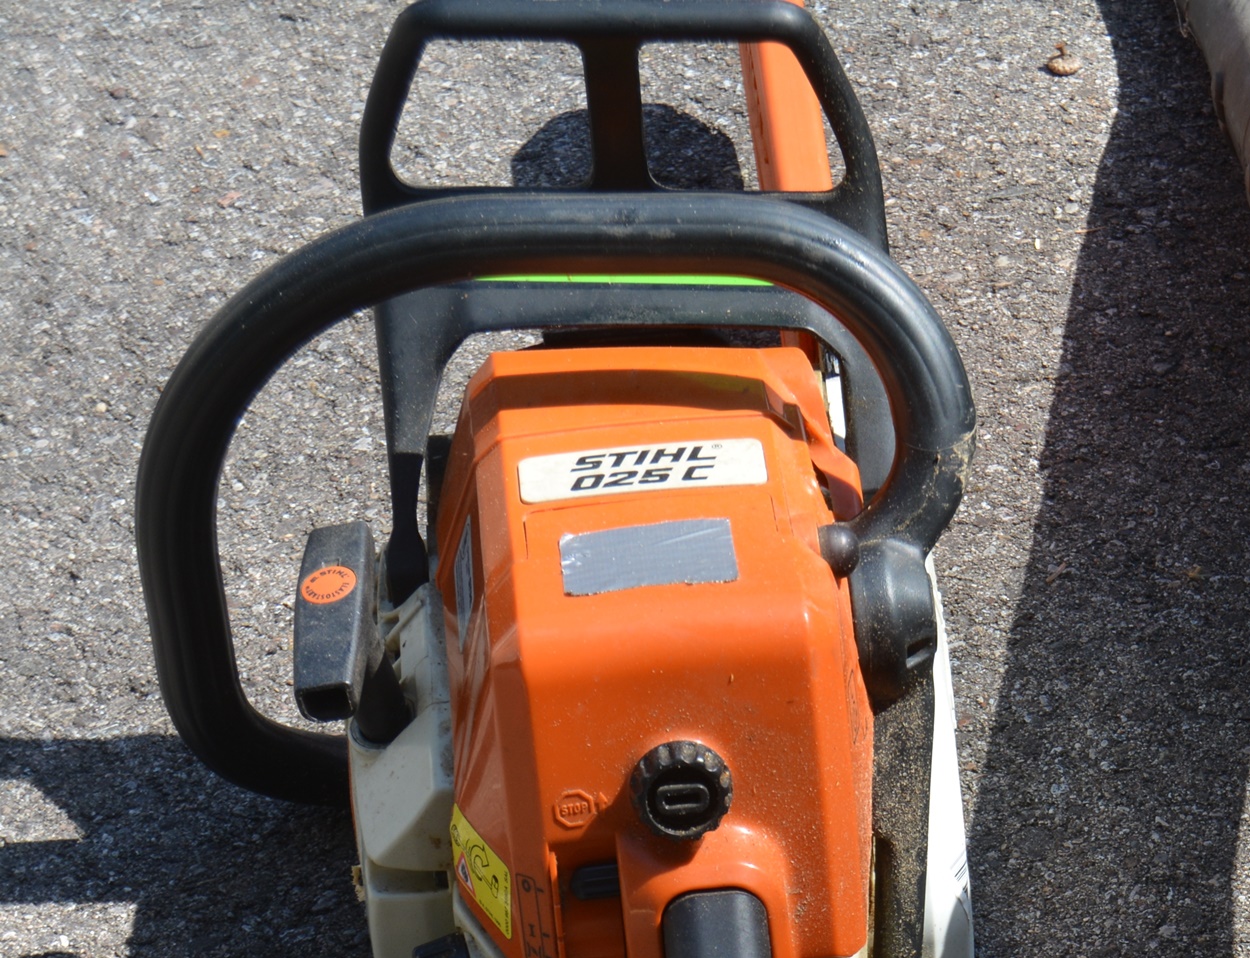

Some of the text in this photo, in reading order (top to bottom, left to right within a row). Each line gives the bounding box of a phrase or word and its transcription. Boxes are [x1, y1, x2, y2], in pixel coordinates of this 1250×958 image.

[570, 465, 715, 491] 025 C
[560, 803, 588, 816] STOP
